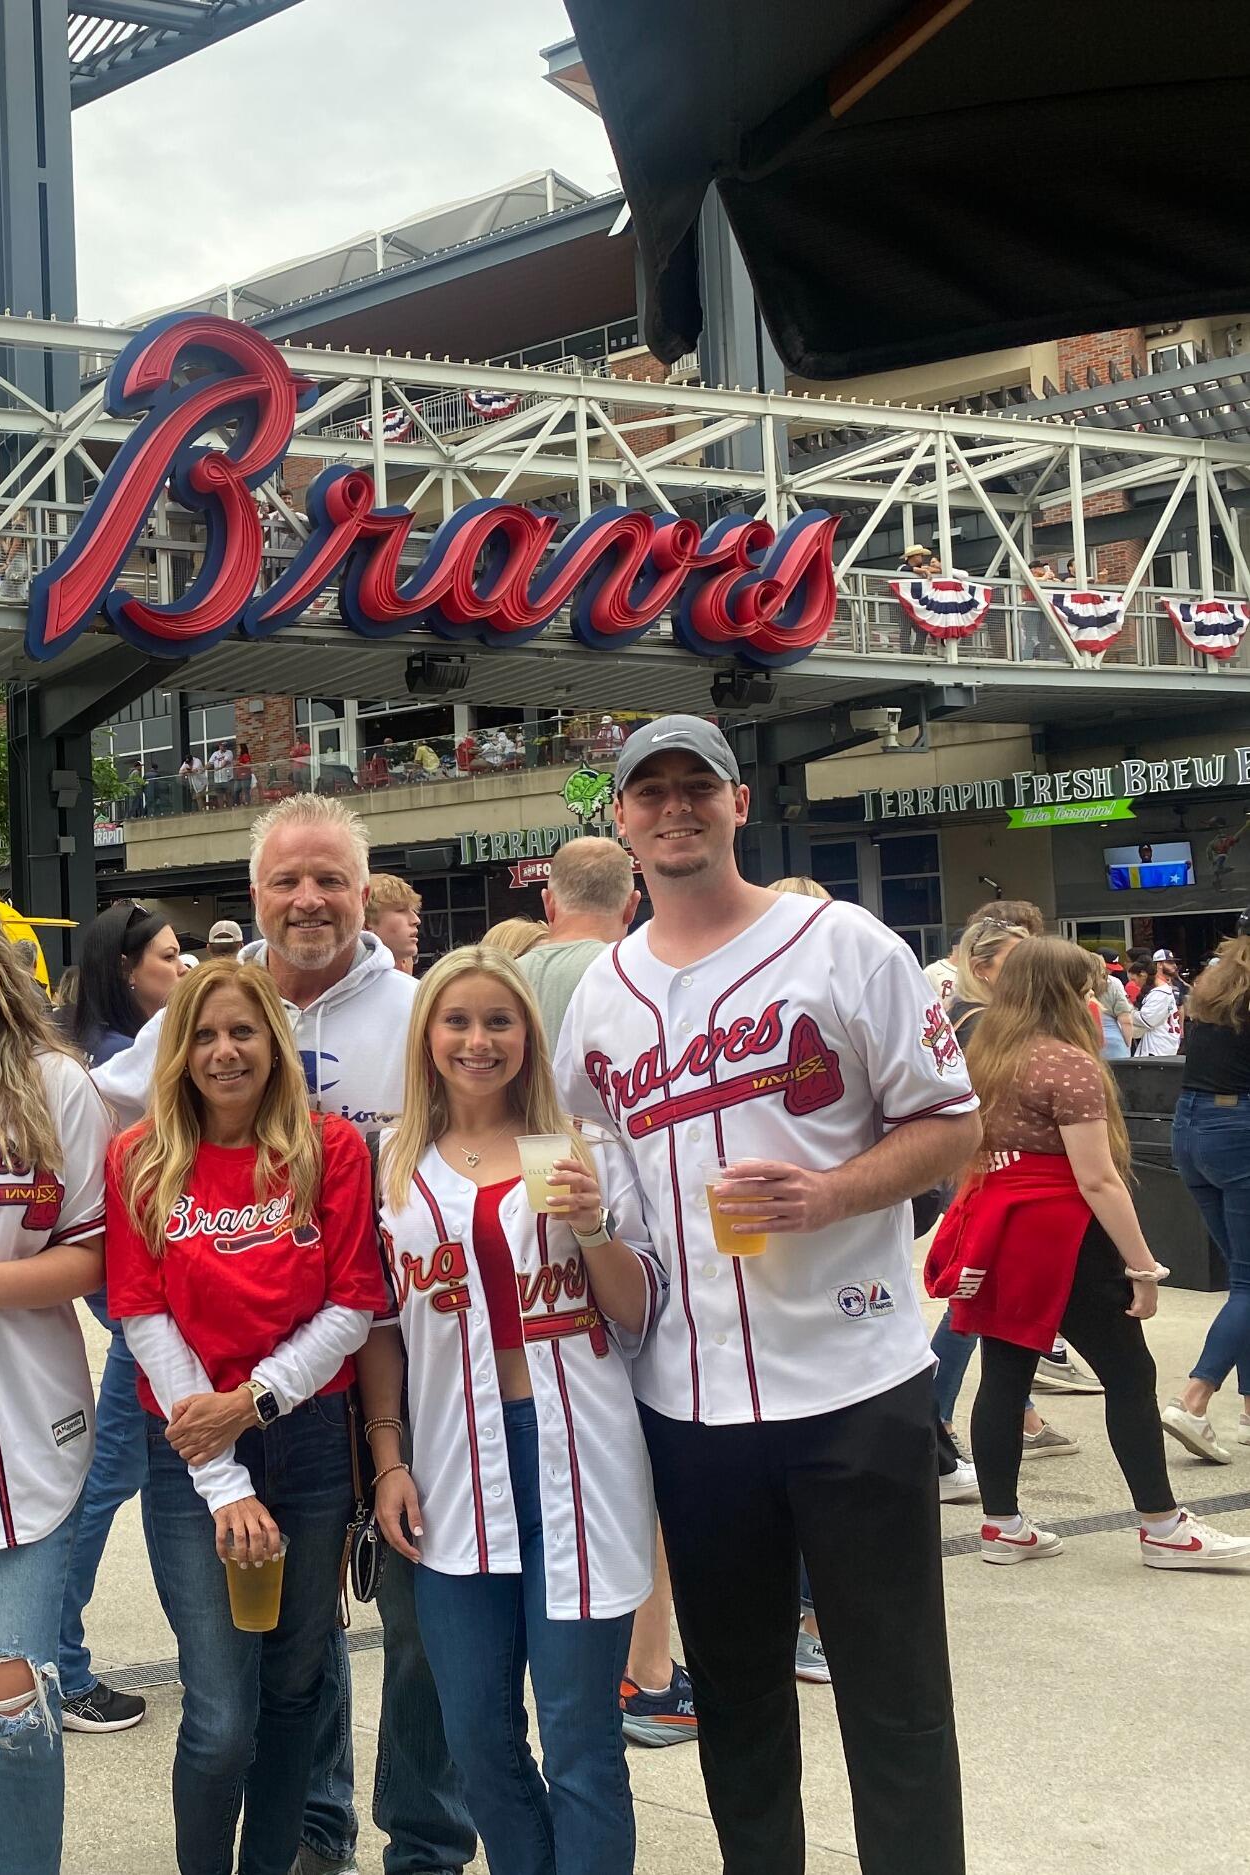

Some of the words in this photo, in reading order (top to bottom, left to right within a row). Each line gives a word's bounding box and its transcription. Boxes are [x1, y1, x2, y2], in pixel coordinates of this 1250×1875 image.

[24, 311, 842, 668] Braves
[858, 778, 1006, 822] TERRAPIN
[1012, 767, 1113, 807] FRESH
[1121, 754, 1225, 797] BREW
[1022, 810, 1049, 823] Take
[455, 823, 584, 865] TERRAPIN
[536, 863, 552, 877] FO
